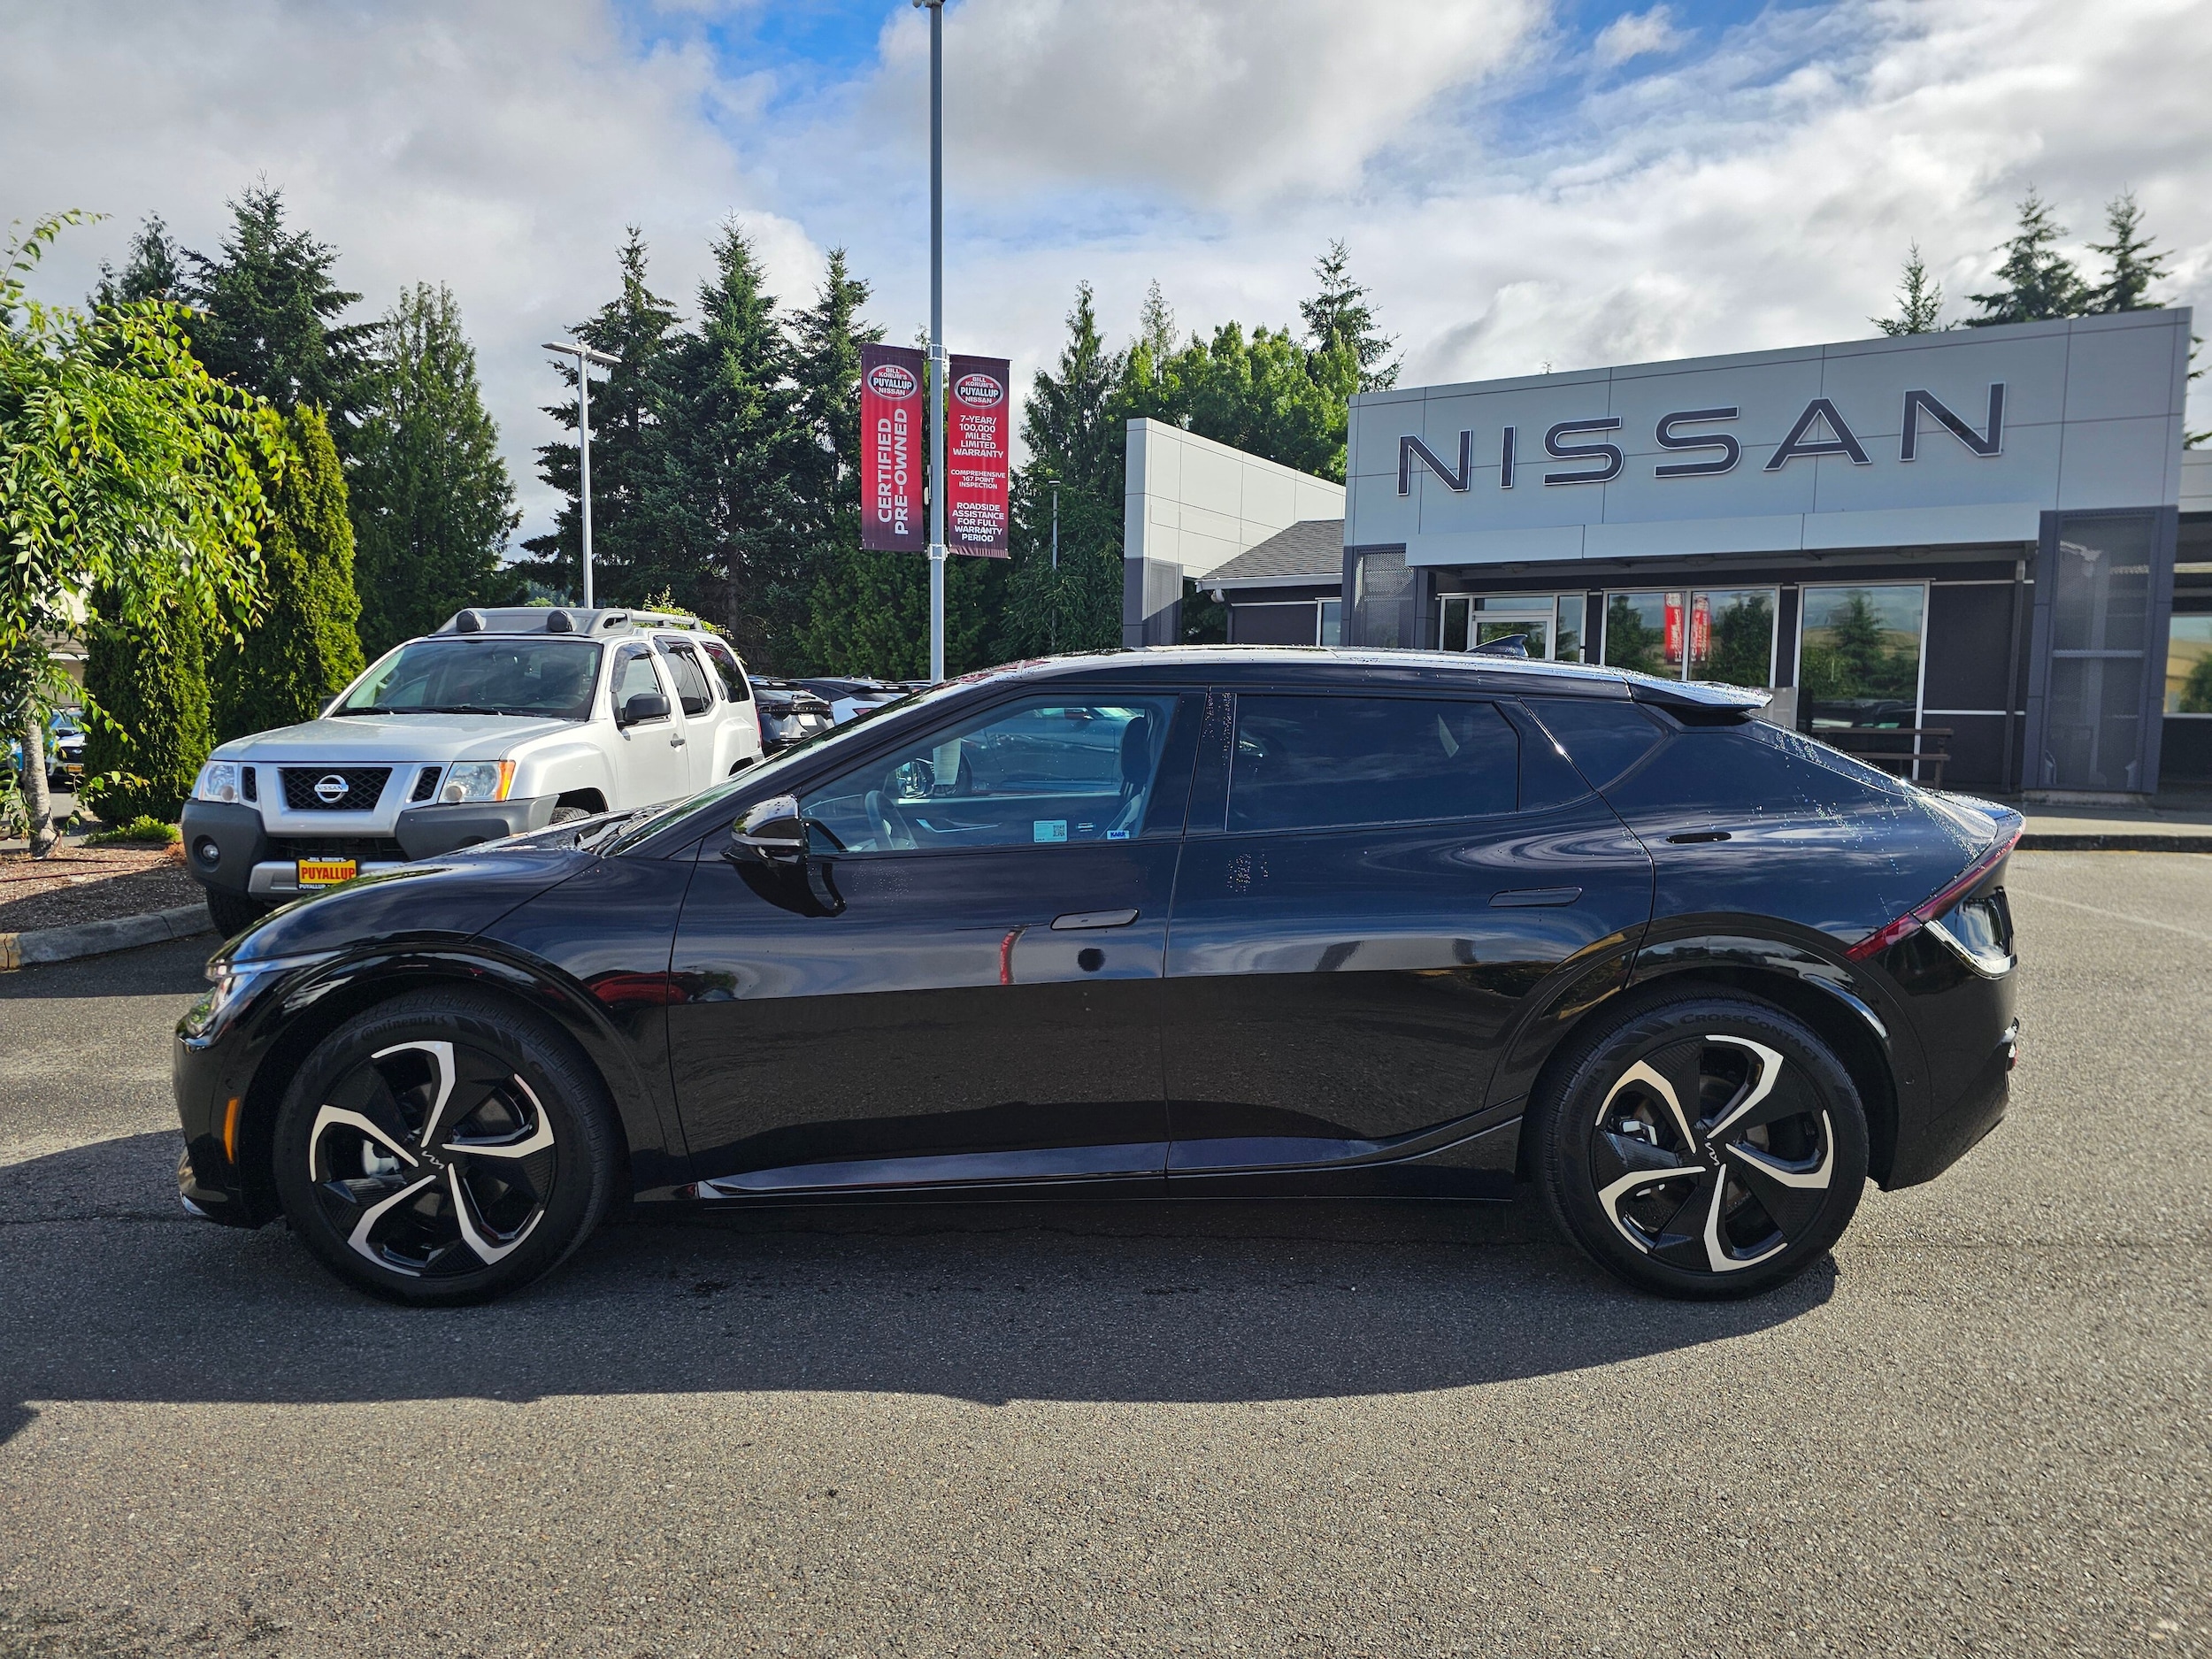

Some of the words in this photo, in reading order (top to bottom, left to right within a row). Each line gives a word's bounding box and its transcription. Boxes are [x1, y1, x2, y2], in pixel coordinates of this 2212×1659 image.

[878, 372, 908, 380] KORUM'S
[872, 378, 912, 390] PUYALLUP
[879, 388, 906, 396] NISSAN
[960, 387, 999, 398] PUYALLUP
[960, 415, 997, 425] 7-YEAR/
[959, 424, 996, 434] 100,000
[965, 432, 993, 441] MILES
[1396, 381, 2007, 496] NISSAN
[960, 440, 997, 449] LIMITED
[952, 447, 1004, 458] WARRANTY
[877, 418, 893, 523] CERTIFIED
[894, 408, 910, 535] PRE-OWNED
[950, 469, 1006, 479] COMPREHENSIVE
[959, 481, 998, 490] INSPECTION
[956, 502, 1001, 512] ROADSIDE
[952, 509, 1005, 520] ASSISTANCE
[957, 517, 976, 526] FOR
[977, 518, 998, 527] FULL
[954, 525, 1004, 535] WARRANTY
[961, 534, 995, 542] PERIOD
[301, 867, 355, 880] PUYALLUP
